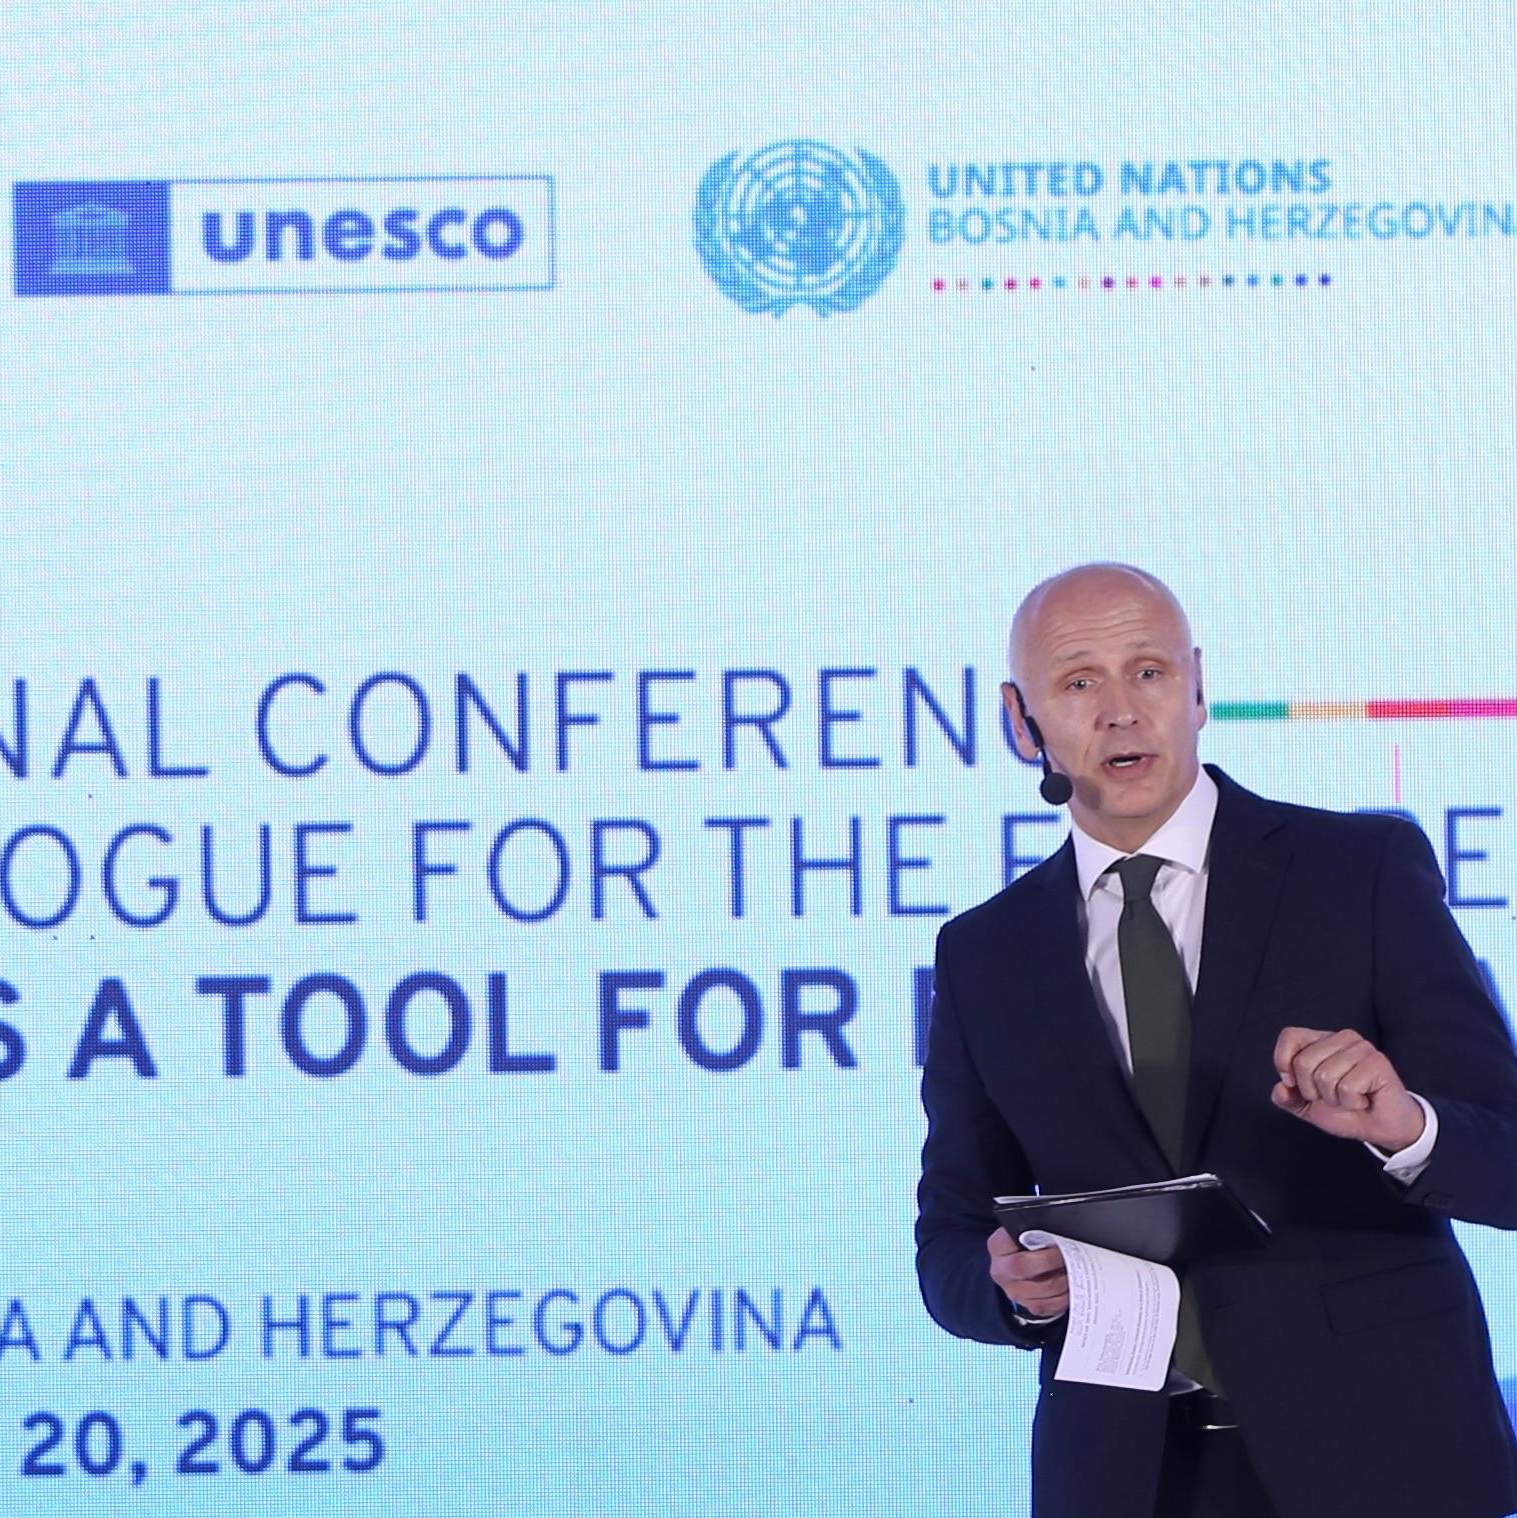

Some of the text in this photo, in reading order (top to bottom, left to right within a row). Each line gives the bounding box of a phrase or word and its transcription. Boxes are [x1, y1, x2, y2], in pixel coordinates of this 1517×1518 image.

[926, 158, 1333, 201] UNITED NATIONS
[201, 206, 526, 265] unesco
[926, 205, 1102, 247] BOSNIA
[1113, 204, 1213, 242] AND
[254, 665, 1046, 780] CONFEREN
[411, 816, 662, 925] FOR
[702, 812, 954, 920] THE
[66, 976, 159, 1081] A
[194, 970, 558, 1080] TOOL
[597, 966, 860, 1074] FOR
[62, 1293, 232, 1363] AND
[260, 1285, 844, 1361] HERZEGOVINA
[19, 1409, 149, 1487] 20,
[174, 1406, 386, 1477] 2025
